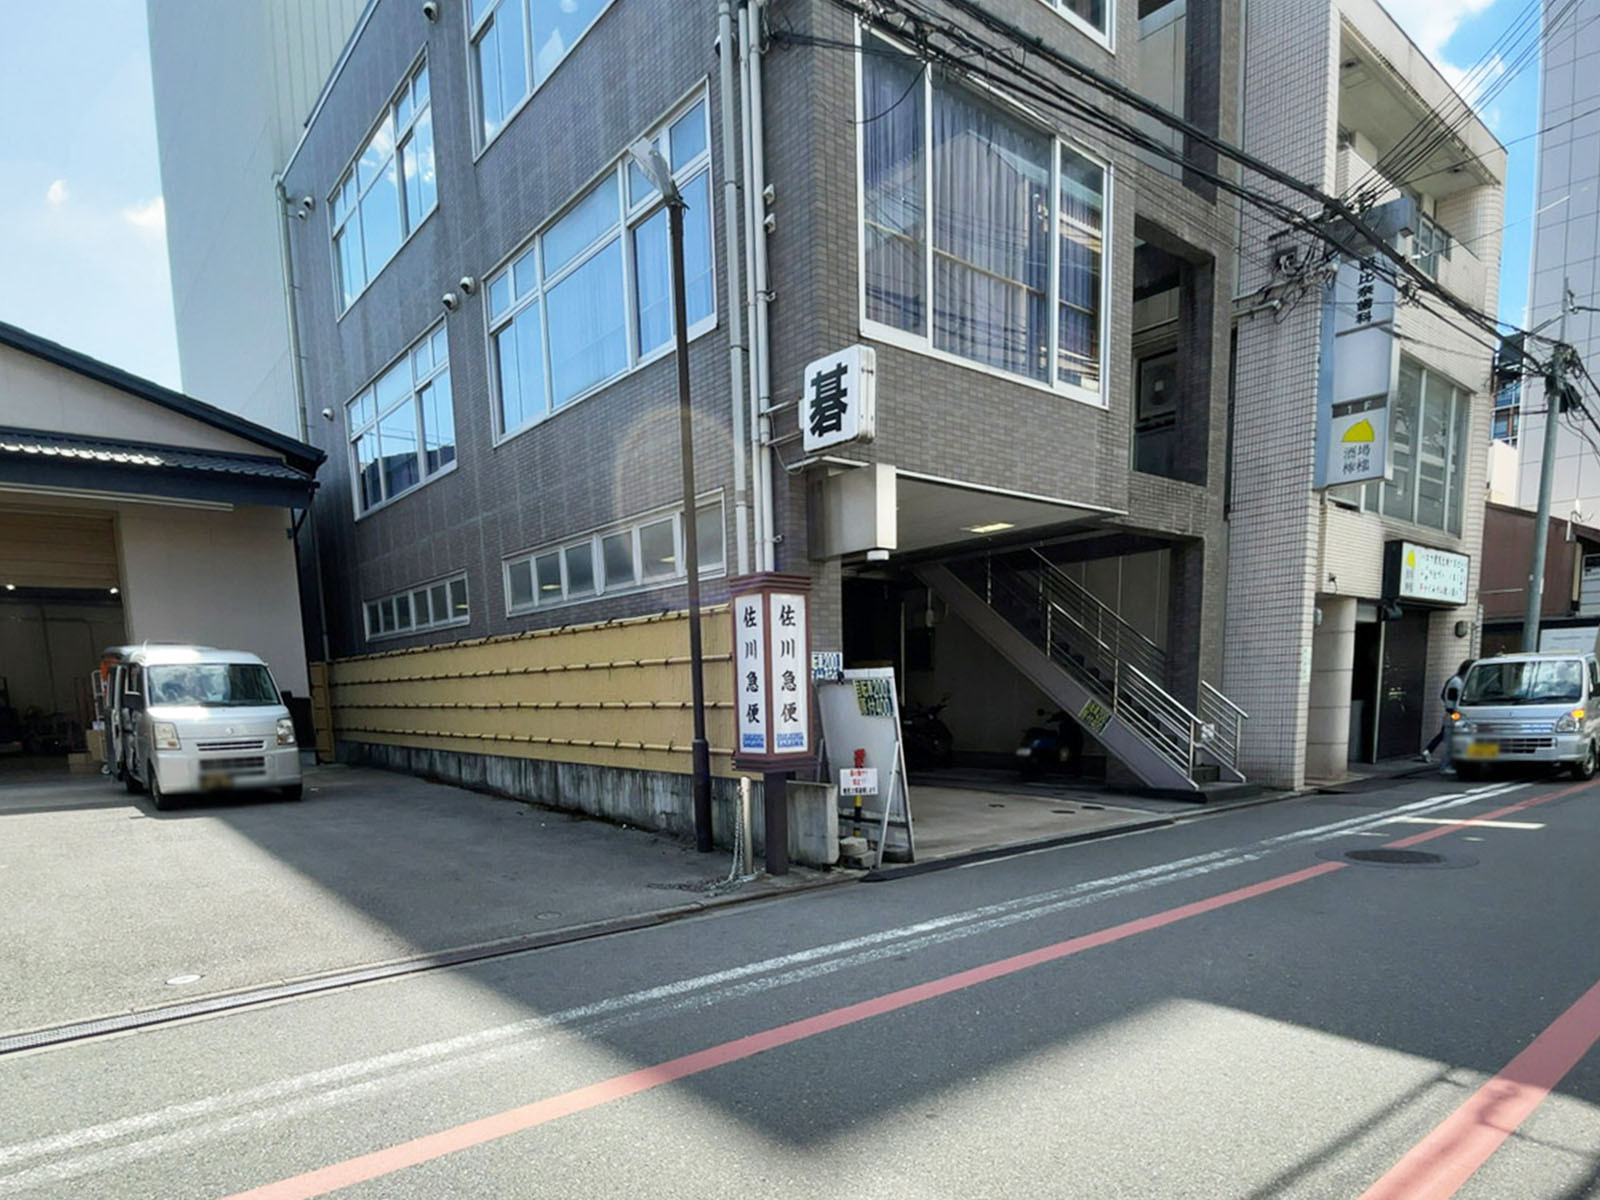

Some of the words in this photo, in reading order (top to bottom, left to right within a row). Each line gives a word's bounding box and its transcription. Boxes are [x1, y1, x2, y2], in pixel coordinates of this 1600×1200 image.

[809, 362, 848, 437] 碁
[743, 606, 761, 724] 佐川急便
[779, 604, 799, 724] 佐川急便
